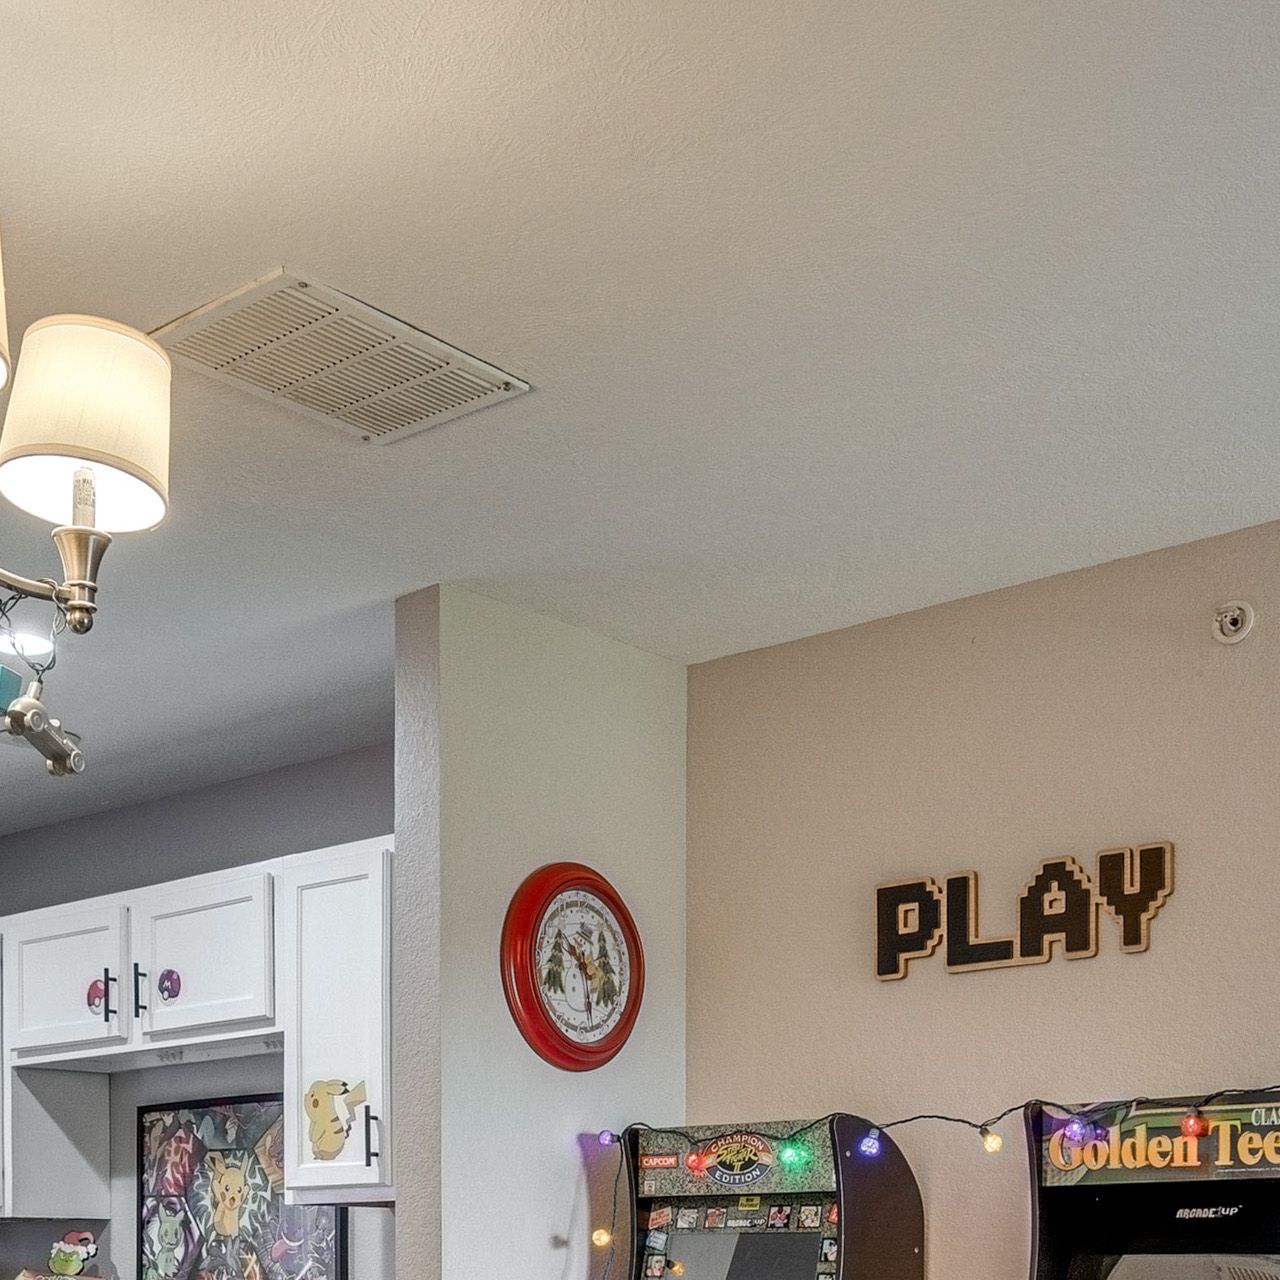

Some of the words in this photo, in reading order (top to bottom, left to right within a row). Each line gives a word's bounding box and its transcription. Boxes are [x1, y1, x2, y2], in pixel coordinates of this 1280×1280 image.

[875, 843, 1173, 979] PLAY
[711, 1133, 765, 1153] CHAMPION
[1048, 1123, 1201, 1172] Golden
[643, 1157, 675, 1167] CAPCOM
[714, 1168, 762, 1183] EDITION
